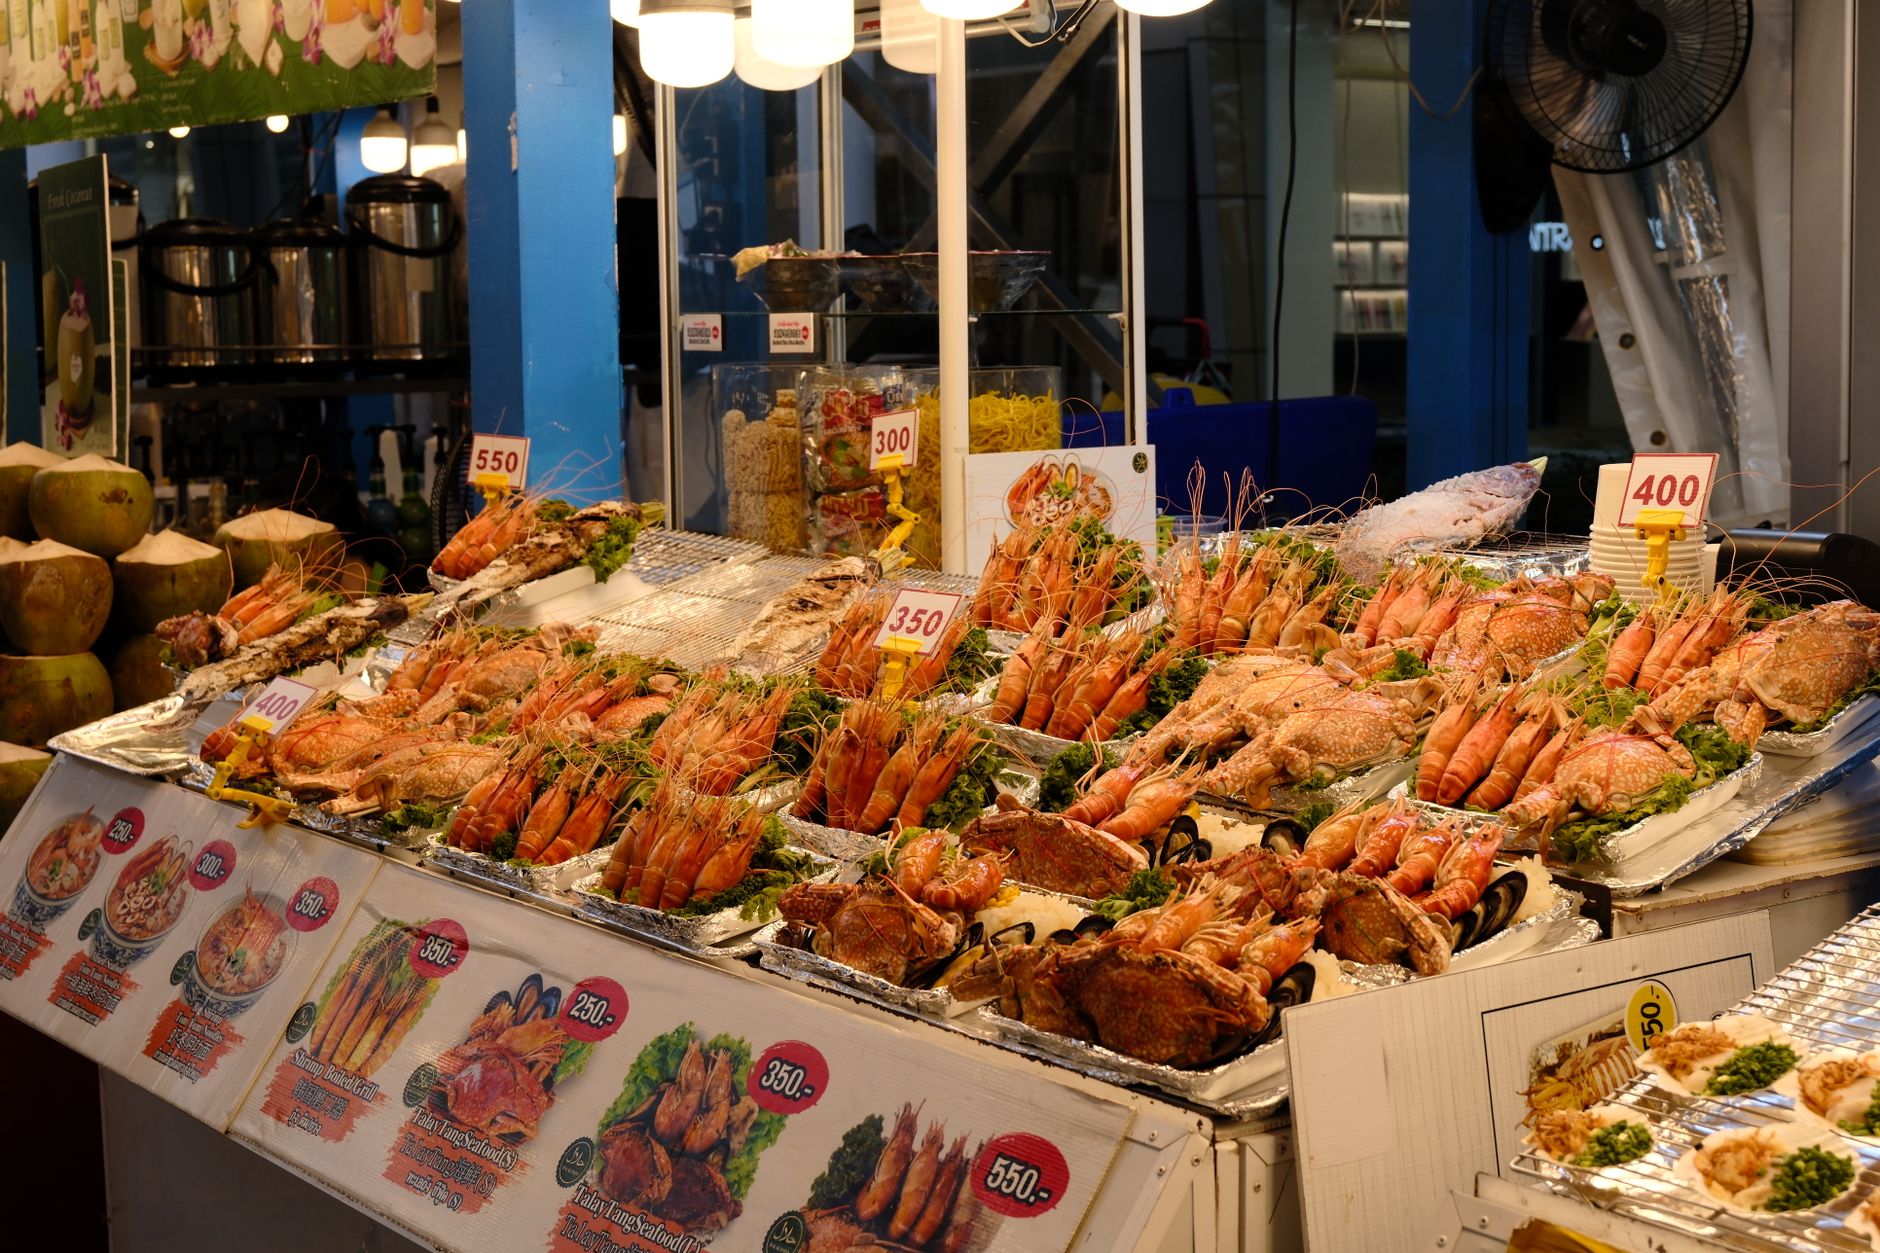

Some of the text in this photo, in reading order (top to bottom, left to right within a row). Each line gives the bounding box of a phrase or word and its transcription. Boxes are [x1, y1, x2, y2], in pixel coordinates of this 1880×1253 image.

[875, 426, 911, 455] 300
[475, 448, 519, 473] 550
[1631, 474, 1700, 507] 400
[888, 606, 944, 637] 350
[255, 692, 299, 721] 400
[107, 818, 135, 843] 250.-
[195, 852, 226, 879] 300.-
[294, 889, 328, 920] 350.-
[418, 934, 459, 967] 350.-
[568, 991, 614, 1027] 250.-
[290, 1047, 380, 1103] Shrimp Boiled/Grill
[760, 1059, 813, 1099] 350.-
[411, 1105, 519, 1173] TalayTangSeafood(S)
[985, 1155, 1050, 1204] 550.-
